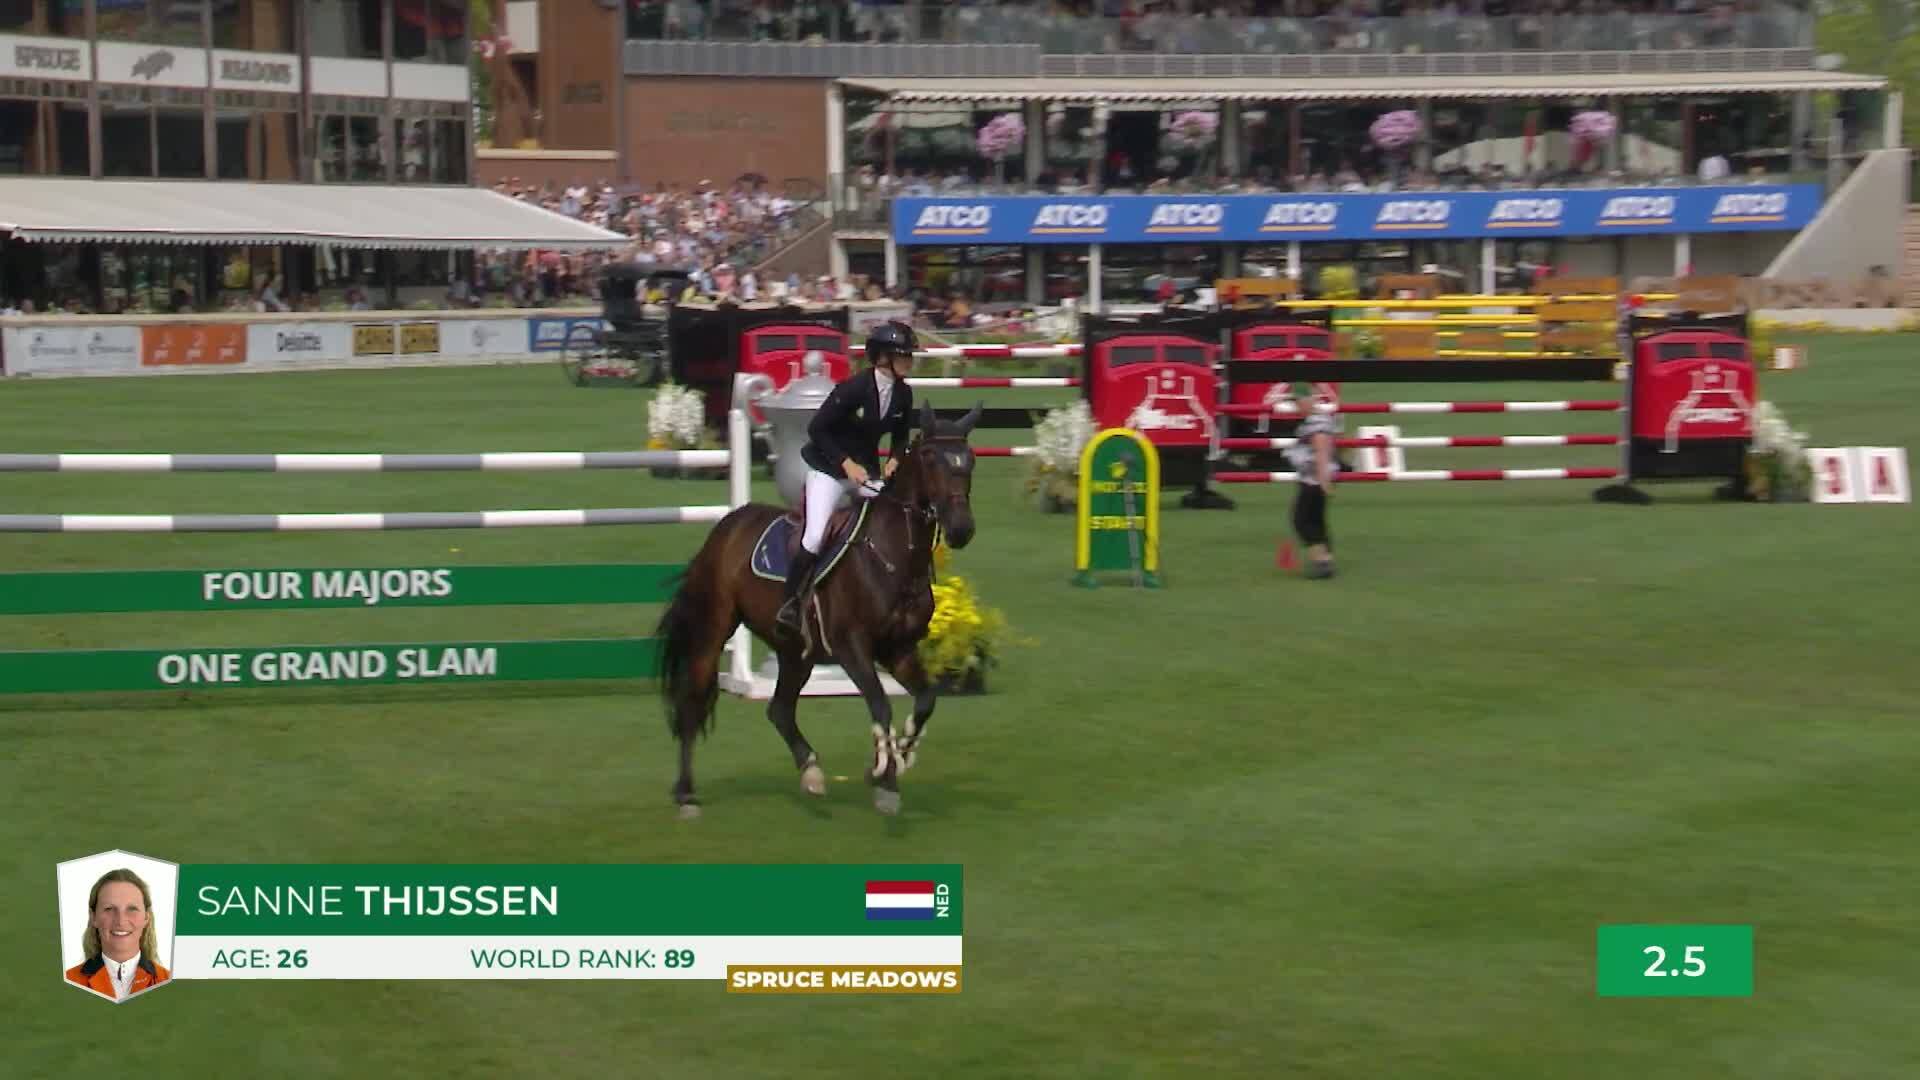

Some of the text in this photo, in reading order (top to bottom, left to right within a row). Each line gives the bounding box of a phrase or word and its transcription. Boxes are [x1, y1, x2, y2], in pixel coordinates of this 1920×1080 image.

[917, 203, 992, 228] ATCO
[1035, 203, 1108, 228] ATCO
[1150, 202, 1224, 227] ATCO
[1265, 201, 1338, 226] ATCO
[1377, 200, 1451, 225] ATCO
[1826, 457, 1844, 494] 3
[203, 568, 453, 605] FOUR MAJORS
[157, 647, 498, 684] ONE GRAND SLAM
